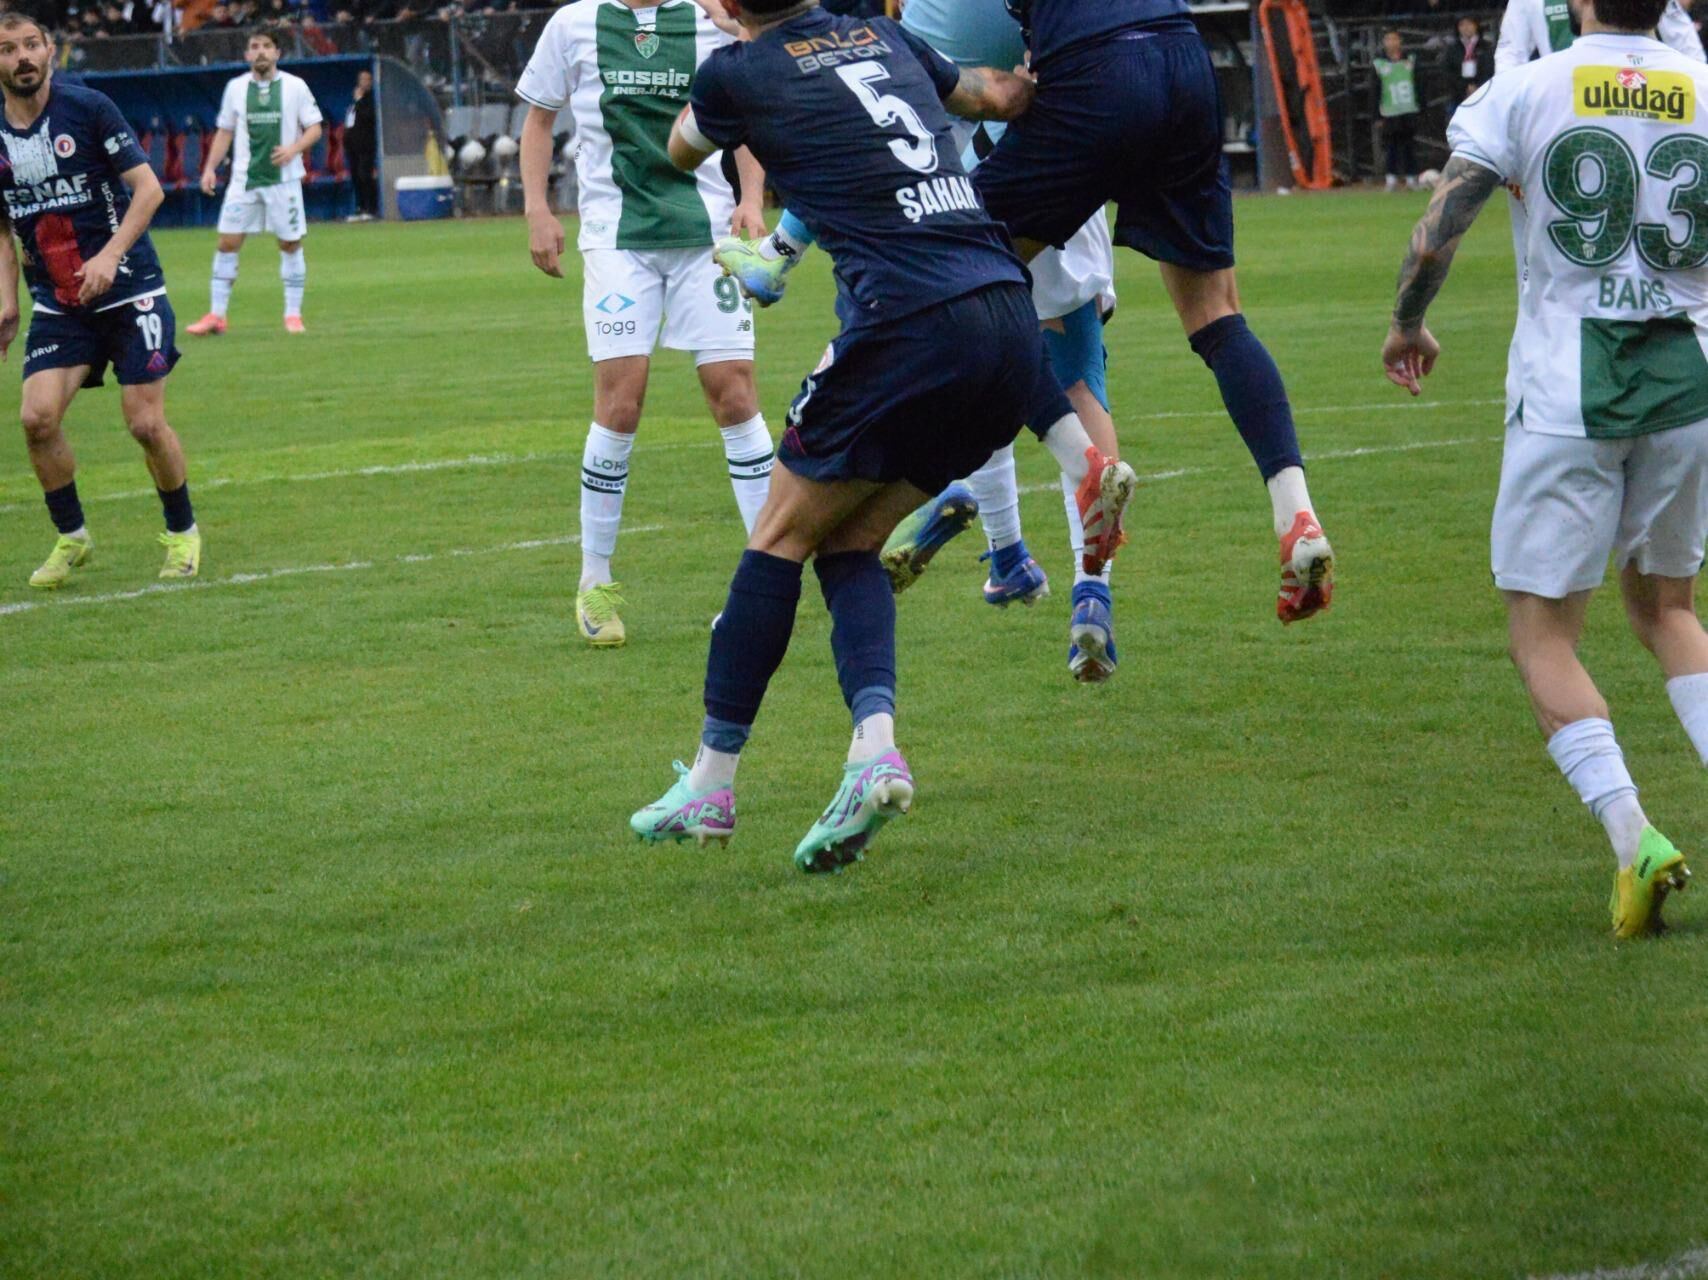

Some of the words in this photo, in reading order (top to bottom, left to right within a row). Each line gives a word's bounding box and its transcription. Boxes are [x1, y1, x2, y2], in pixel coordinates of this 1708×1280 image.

[796, 40, 893, 75] BETON
[834, 59, 939, 174] 5
[1583, 80, 1685, 120] uludağ
[3, 173, 88, 204] ESNAF
[1542, 125, 1708, 271] 93
[136, 313, 163, 351] 19
[595, 319, 636, 336] Togg
